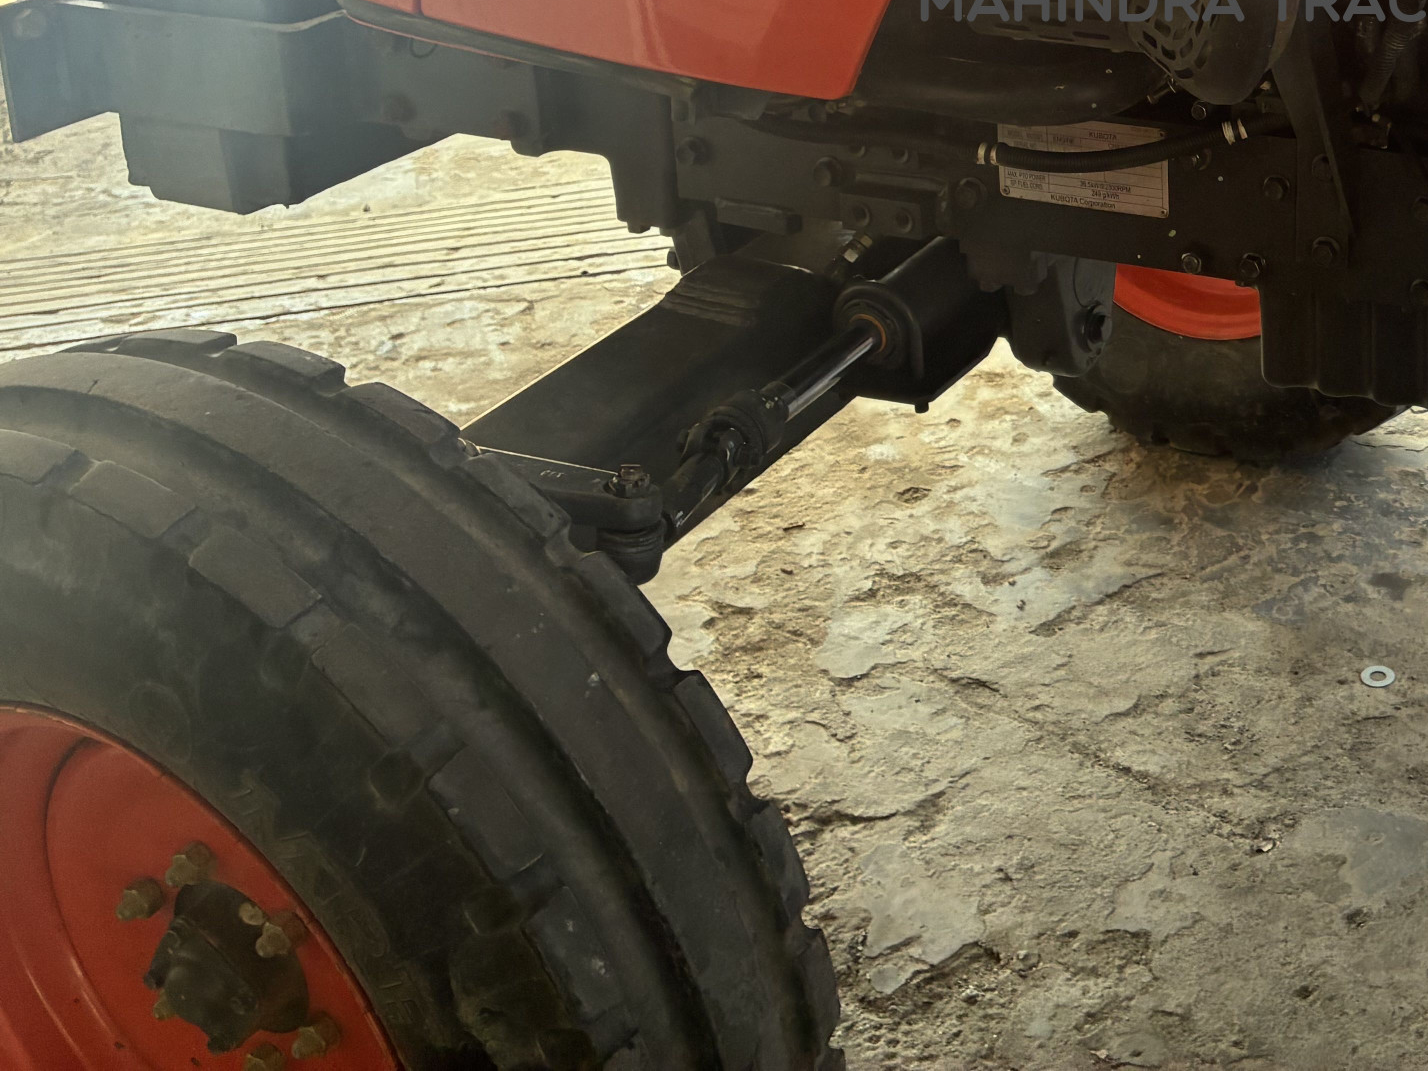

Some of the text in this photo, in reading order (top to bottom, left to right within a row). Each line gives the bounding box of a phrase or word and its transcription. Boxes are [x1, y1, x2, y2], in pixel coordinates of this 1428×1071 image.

[1088, 131, 1118, 141] KUBOTA
[1050, 193, 1116, 209] KUBOTA Corporation
